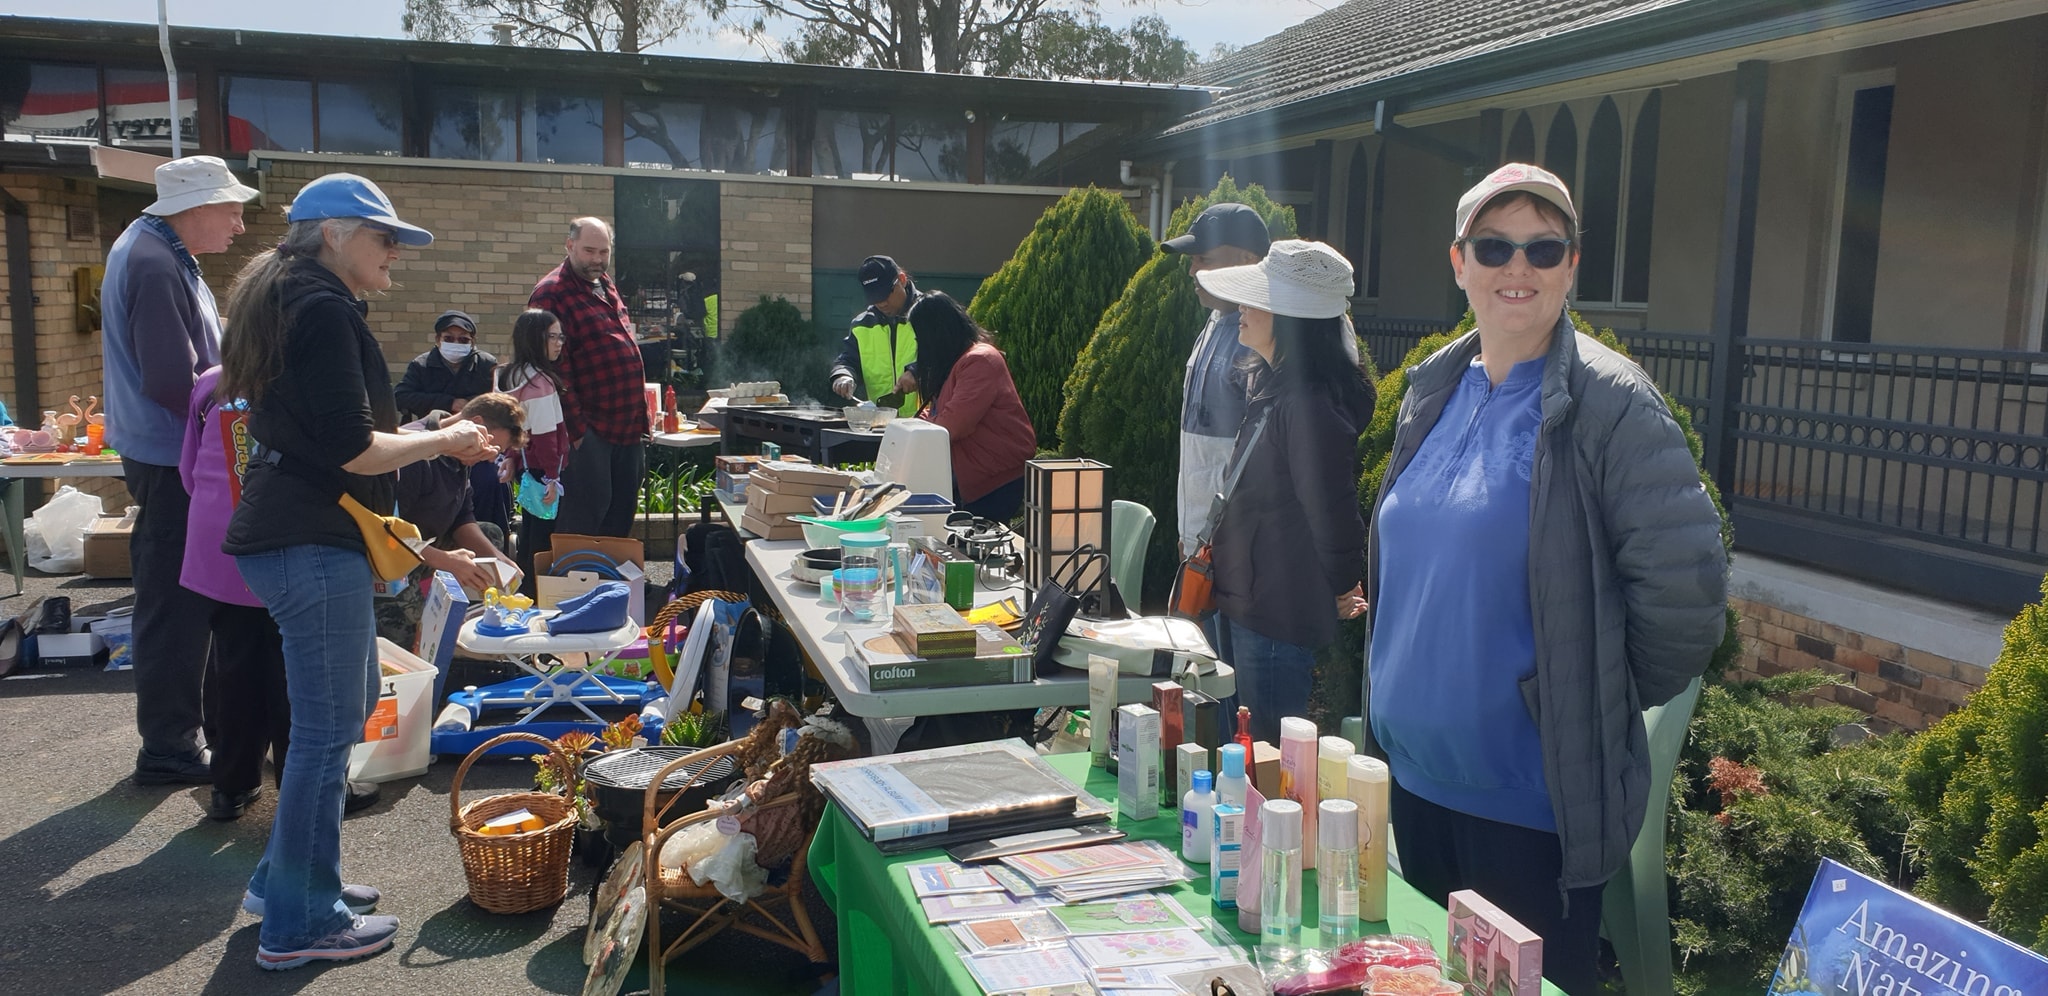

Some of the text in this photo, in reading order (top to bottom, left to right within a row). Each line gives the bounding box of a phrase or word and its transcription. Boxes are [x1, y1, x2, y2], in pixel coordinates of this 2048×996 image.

[232, 421, 250, 481] Garag
[874, 666, 916, 680] crofton
[1837, 949, 1922, 996] Nat
